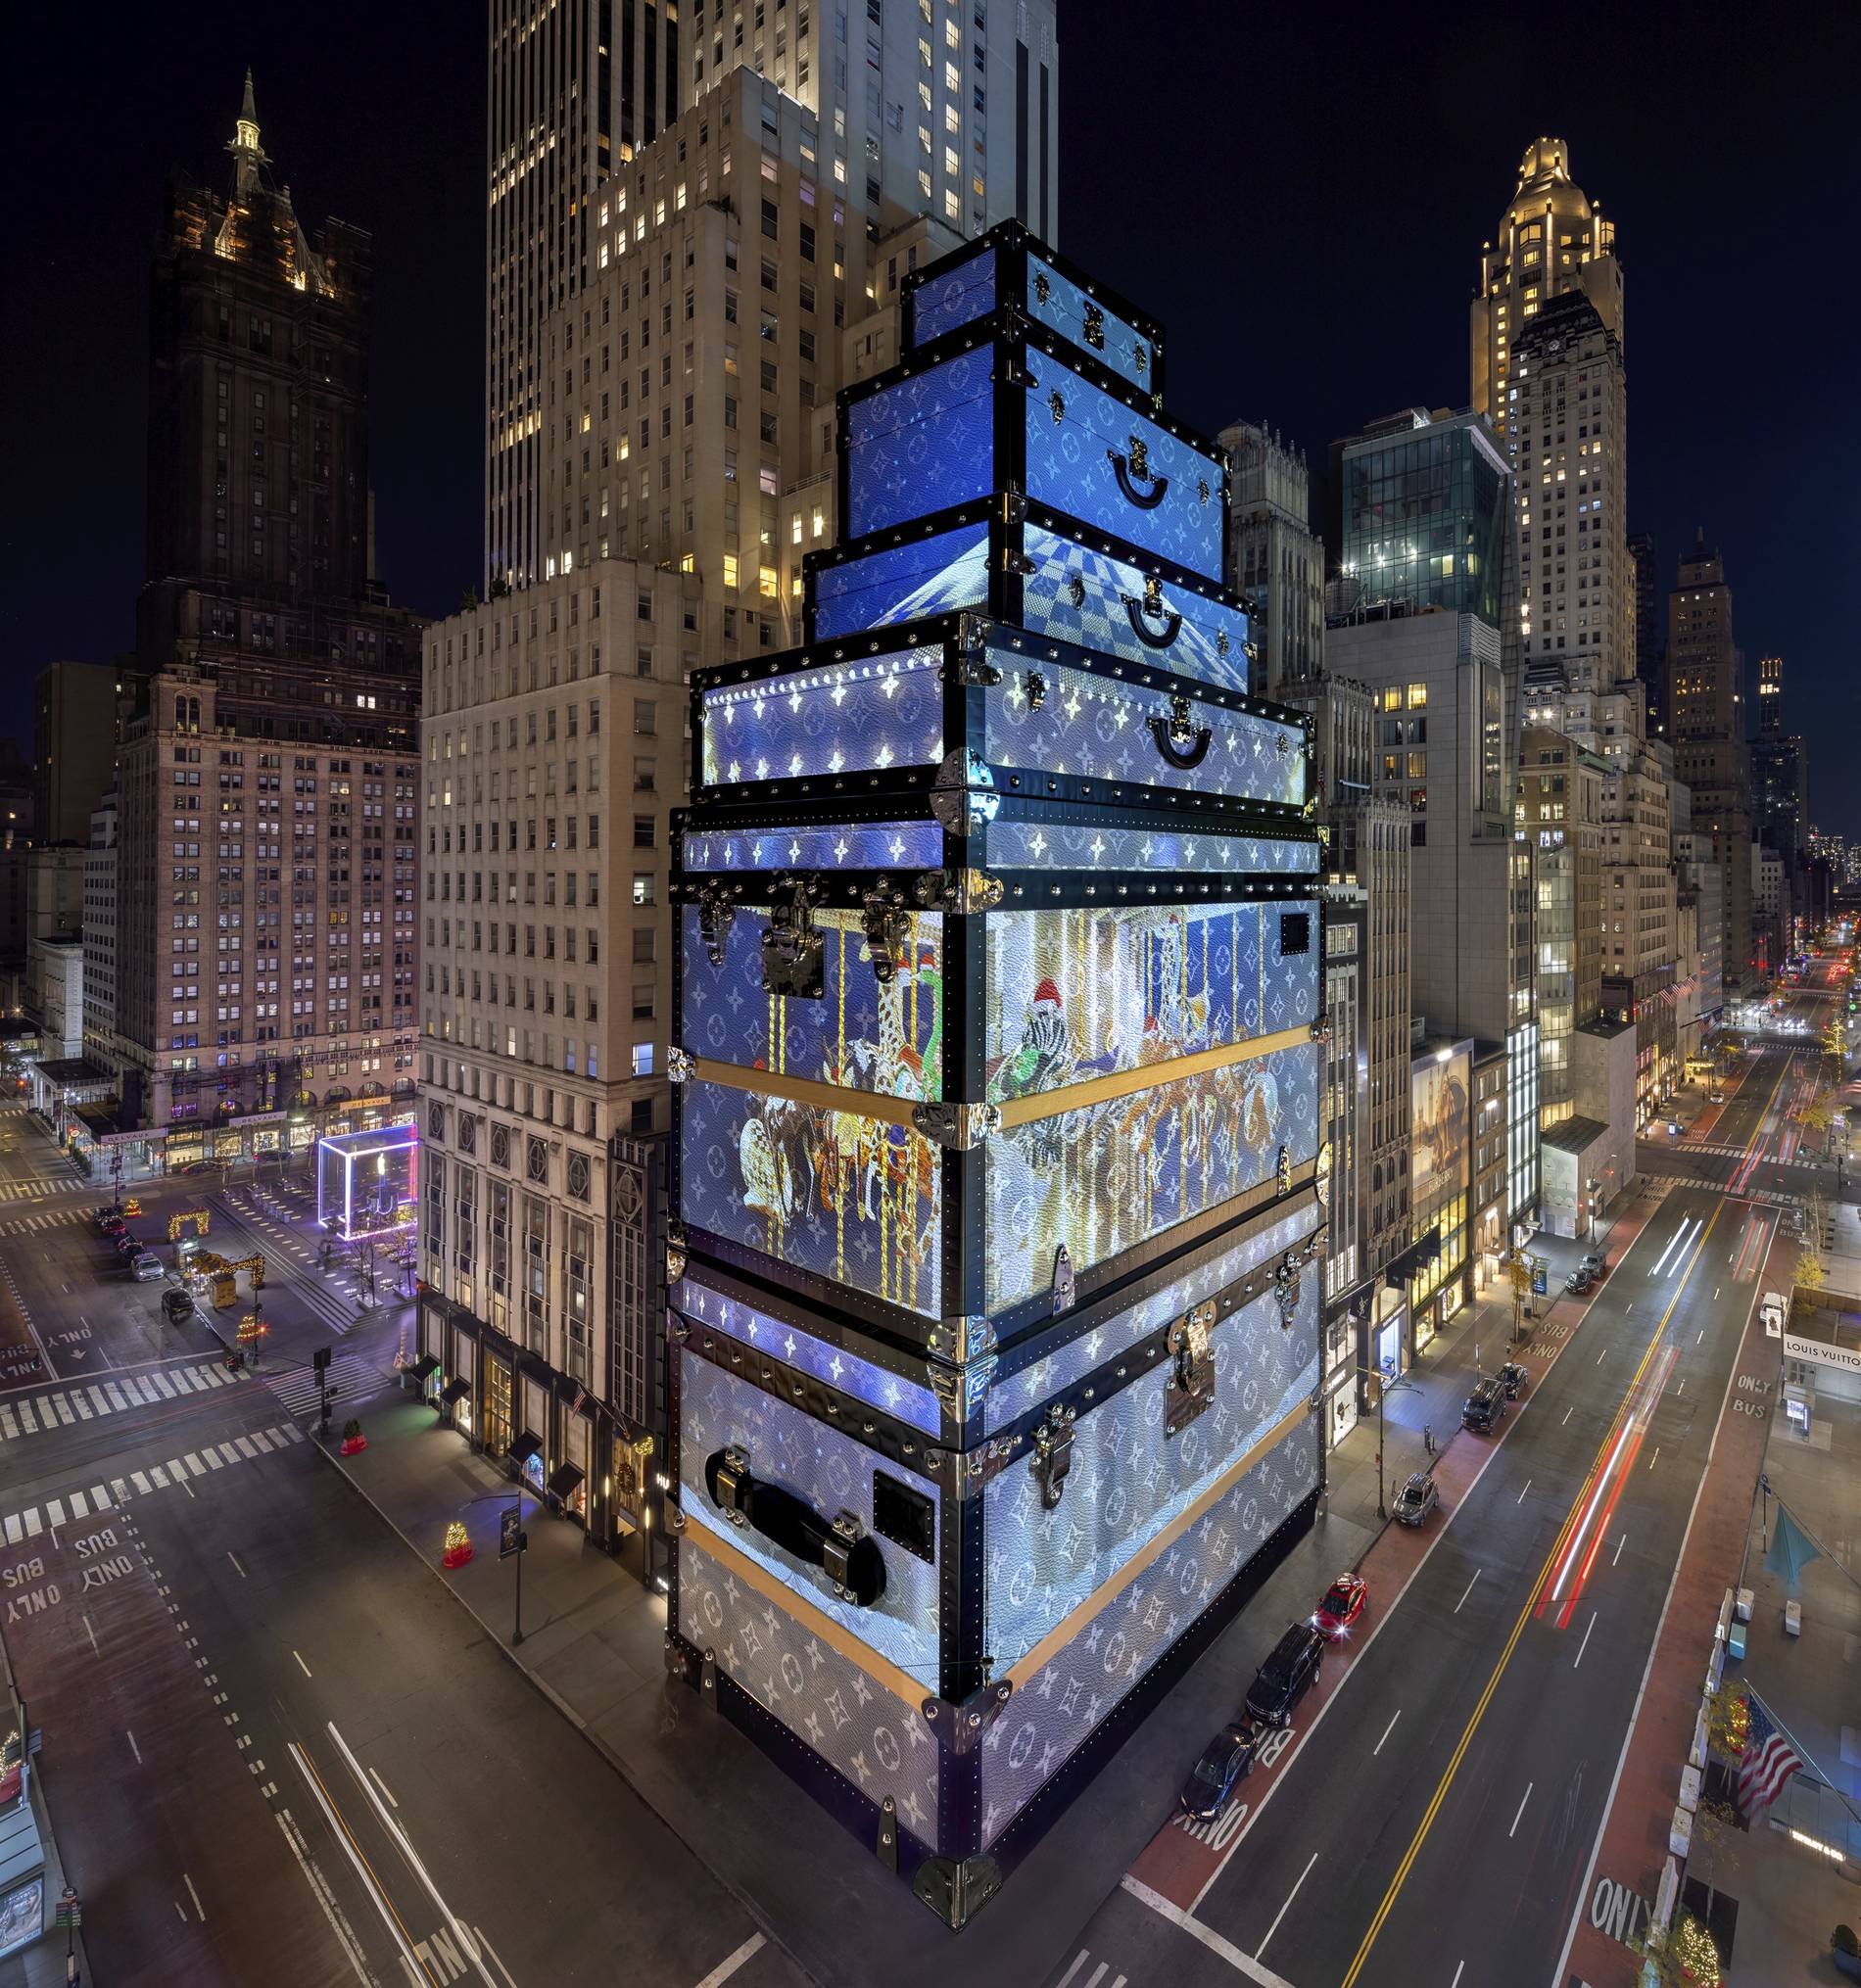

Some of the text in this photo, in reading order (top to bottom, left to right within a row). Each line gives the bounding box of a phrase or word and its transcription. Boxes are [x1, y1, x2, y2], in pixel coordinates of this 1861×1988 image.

[108, 1132, 149, 1142] DELVAUX
[48, 1328, 92, 1348] ONLY
[1542, 1323, 1568, 1338] BUS
[1522, 1342, 1557, 1358] ONLY
[1787, 1341, 1819, 1356] LOUIS
[1738, 1375, 1772, 1396] ONLY
[1733, 1398, 1766, 1419] BUS
[74, 1528, 119, 1559] BUS
[2, 1557, 44, 1588] BUS
[82, 1555, 134, 1593] ONLY
[7, 1584, 61, 1624] ONLY
